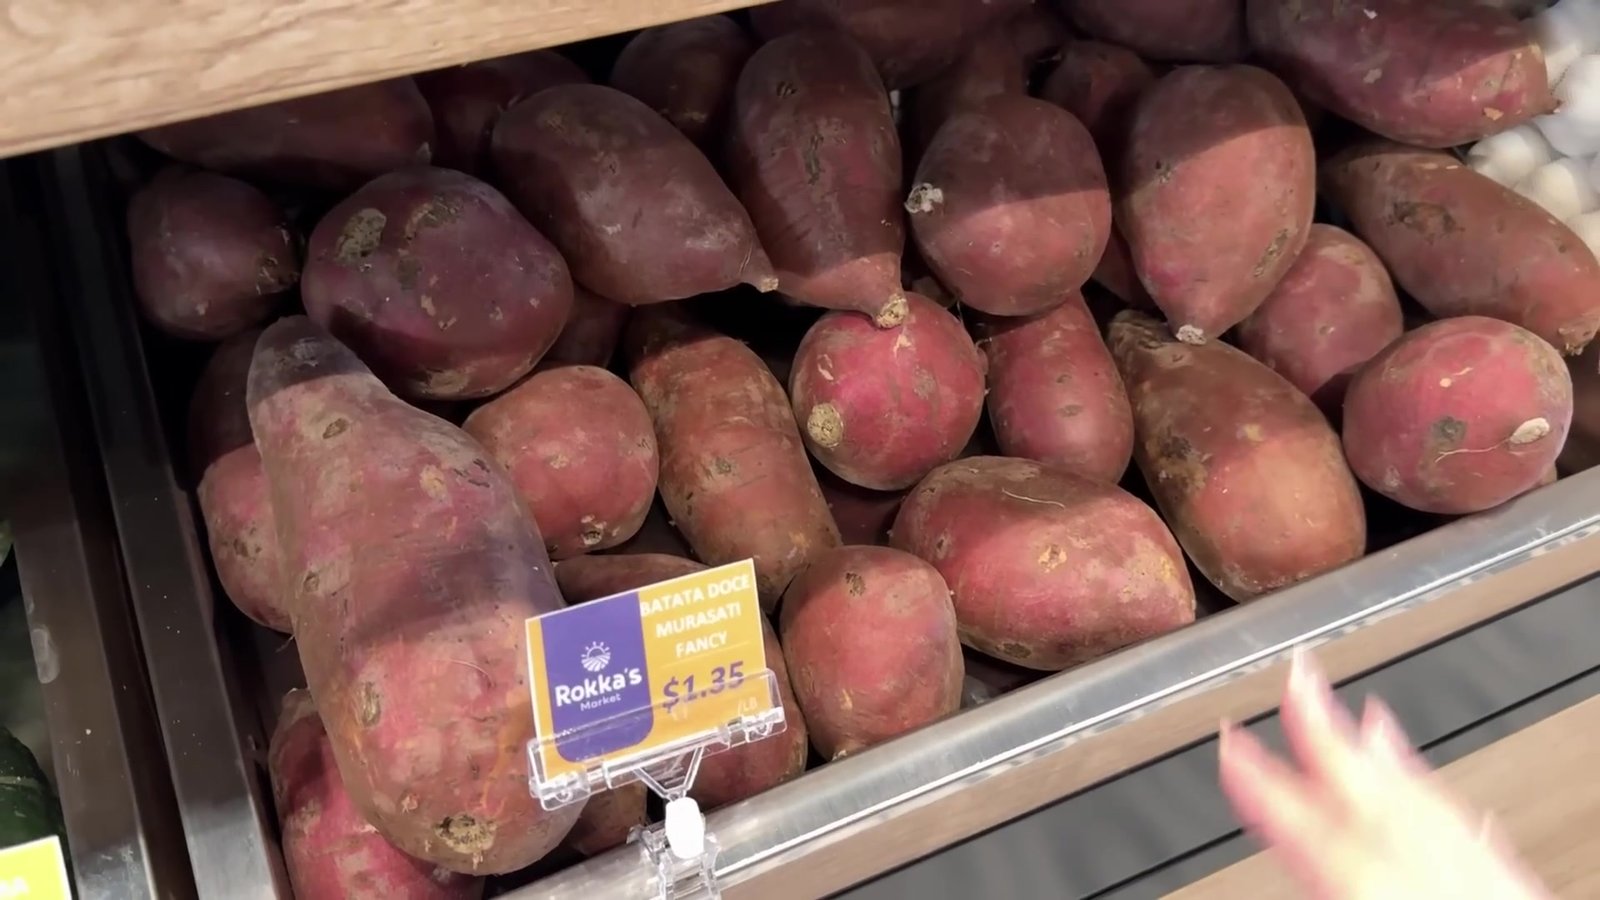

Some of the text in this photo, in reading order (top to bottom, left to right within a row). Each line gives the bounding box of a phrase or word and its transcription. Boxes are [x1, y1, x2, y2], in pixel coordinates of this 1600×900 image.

[639, 574, 750, 617] BATATA DOCE
[655, 602, 742, 638] MURASATI
[675, 631, 728, 658] FANCY
[554, 667, 643, 707] Rokka's
[580, 693, 622, 712] Market
[662, 660, 745, 714] $1.35
